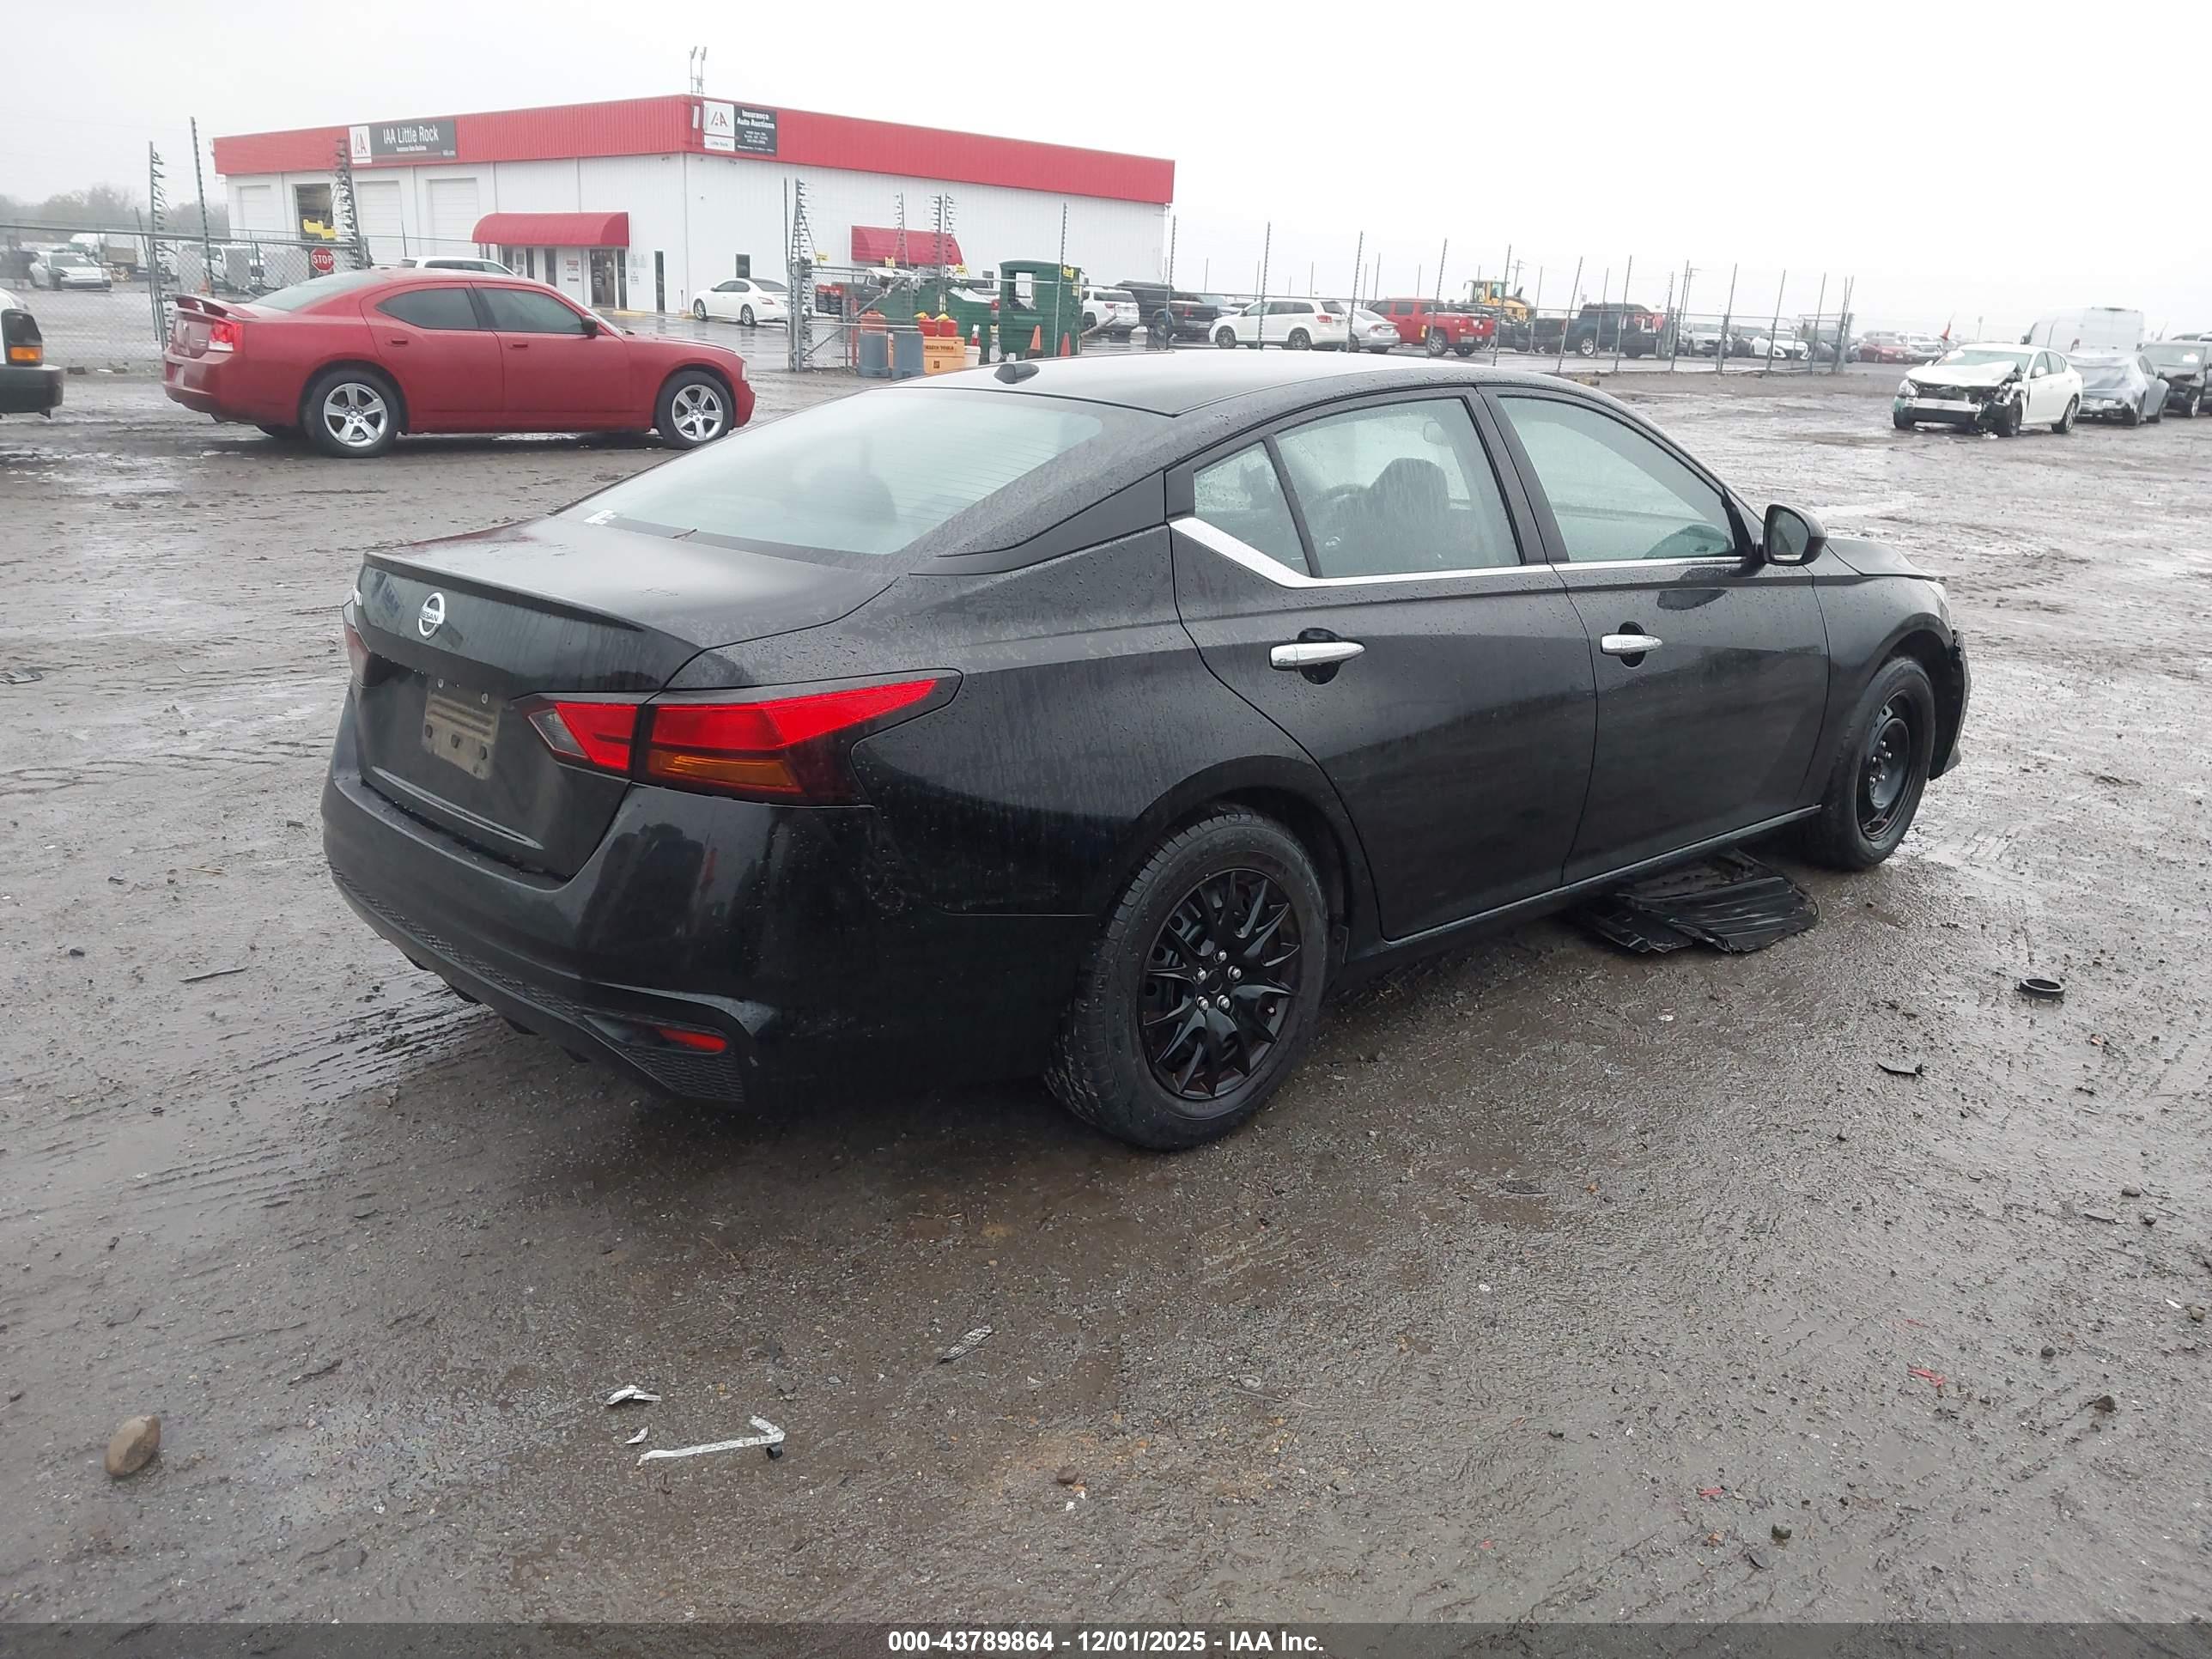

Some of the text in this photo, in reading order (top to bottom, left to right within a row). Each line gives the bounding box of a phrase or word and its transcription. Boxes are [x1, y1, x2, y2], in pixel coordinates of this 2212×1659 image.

[383, 124, 439, 144] IAA Little Rock
[313, 254, 333, 264] STOP
[420, 609, 441, 623] SSAN
